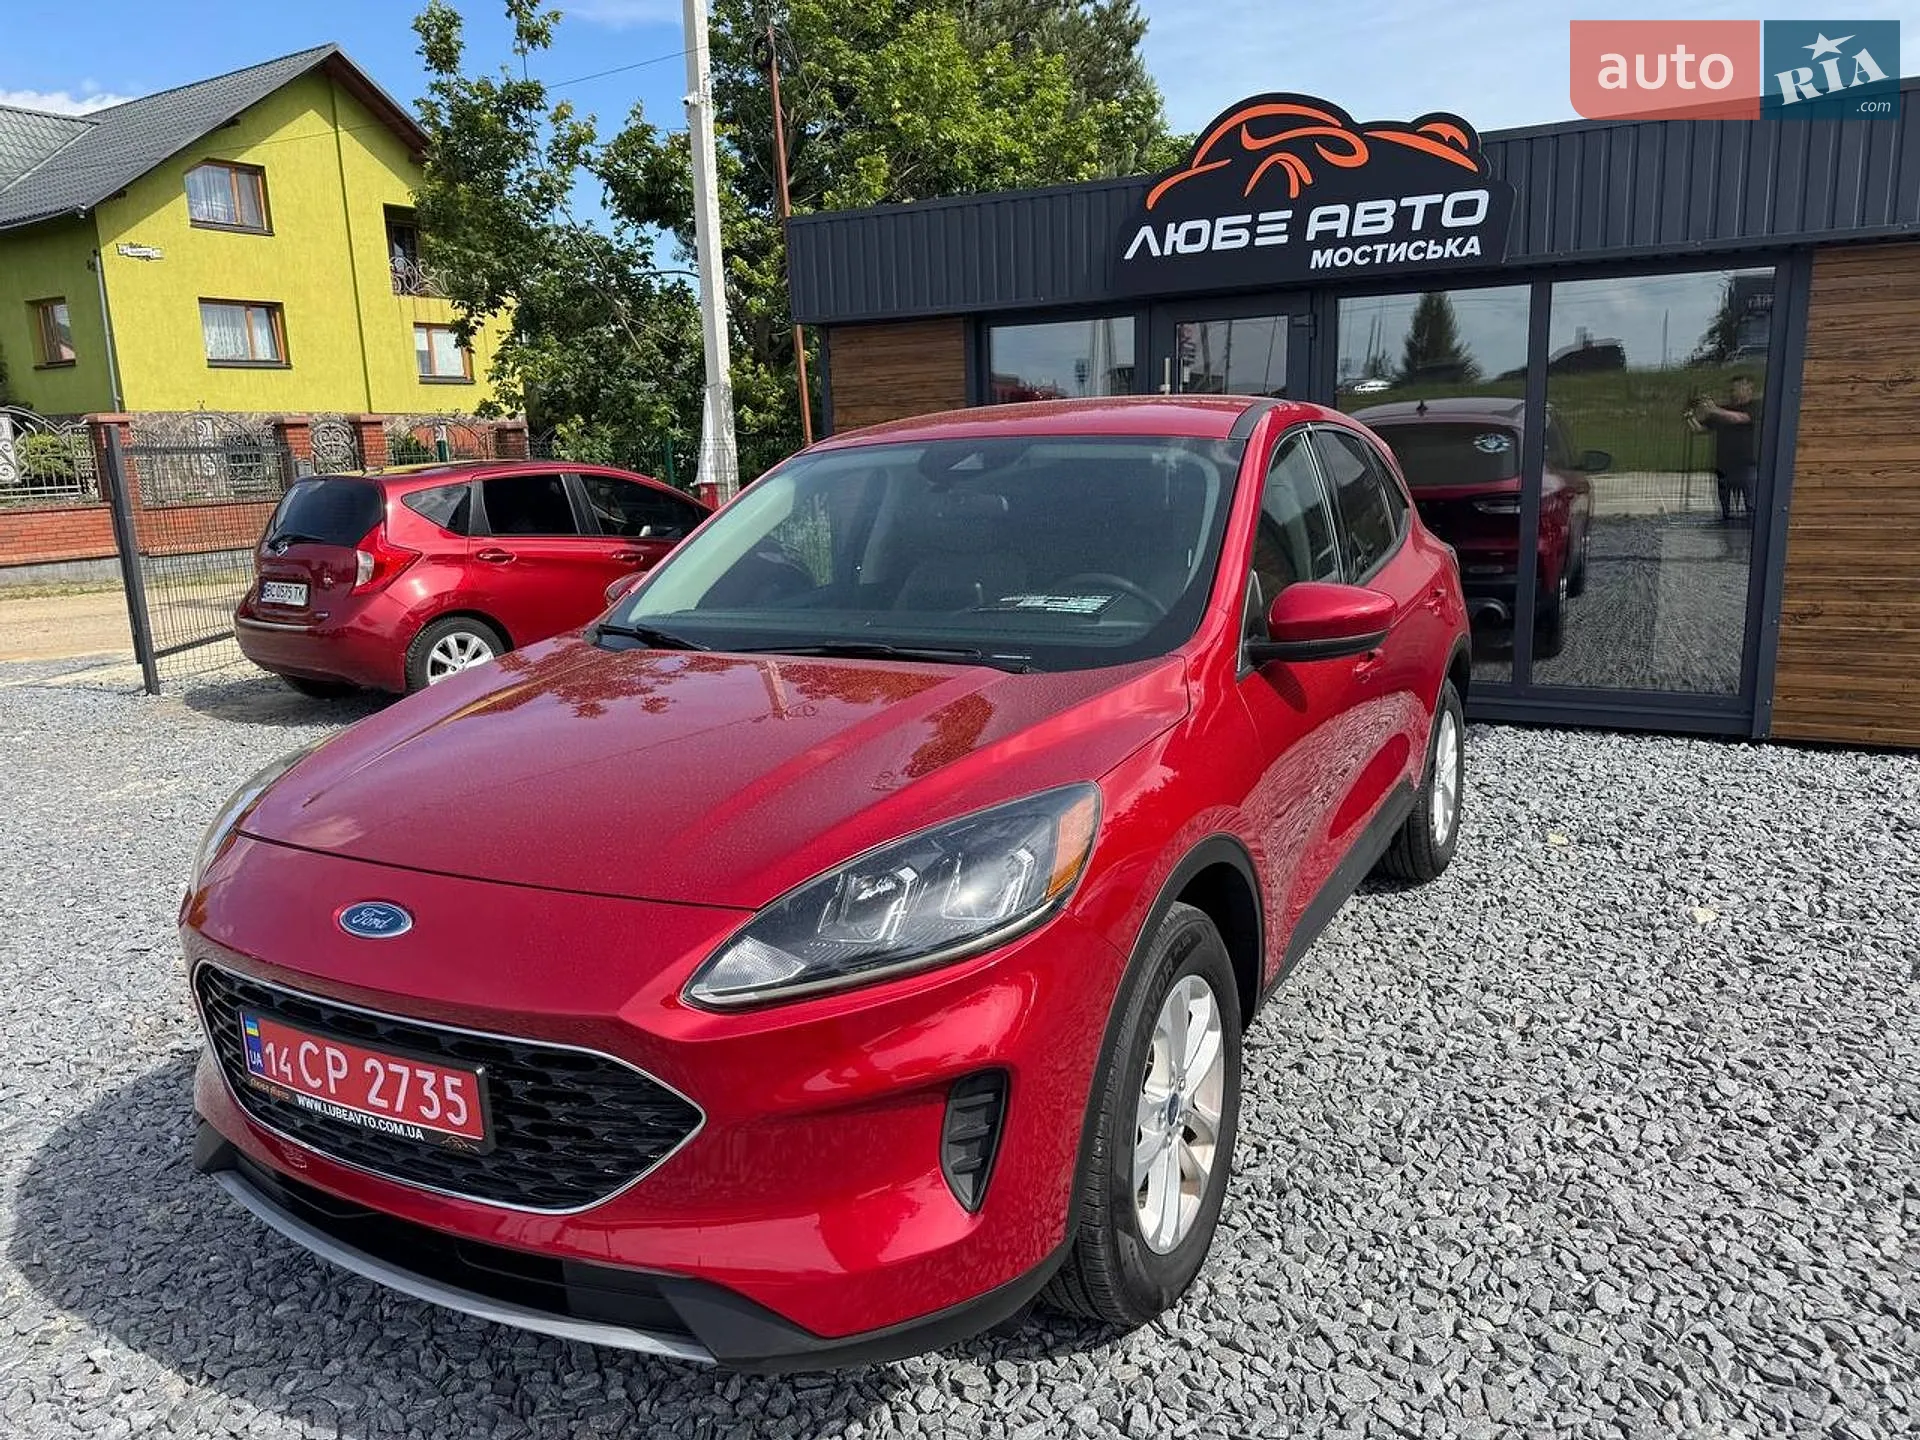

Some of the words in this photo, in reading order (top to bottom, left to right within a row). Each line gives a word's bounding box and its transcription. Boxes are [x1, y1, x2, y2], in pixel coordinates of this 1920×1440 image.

[1124, 210, 1294, 260] ЛЮБЕ
[1305, 189, 1490, 242] АВТО
[1309, 236, 1483, 270] МОСТИСЬКА
[352, 907, 394, 929] Ford
[250, 1051, 264, 1068] UA
[364, 1057, 468, 1126] 2735
[296, 1093, 425, 1141] WWW.LUBEAVTO.COM.UA
